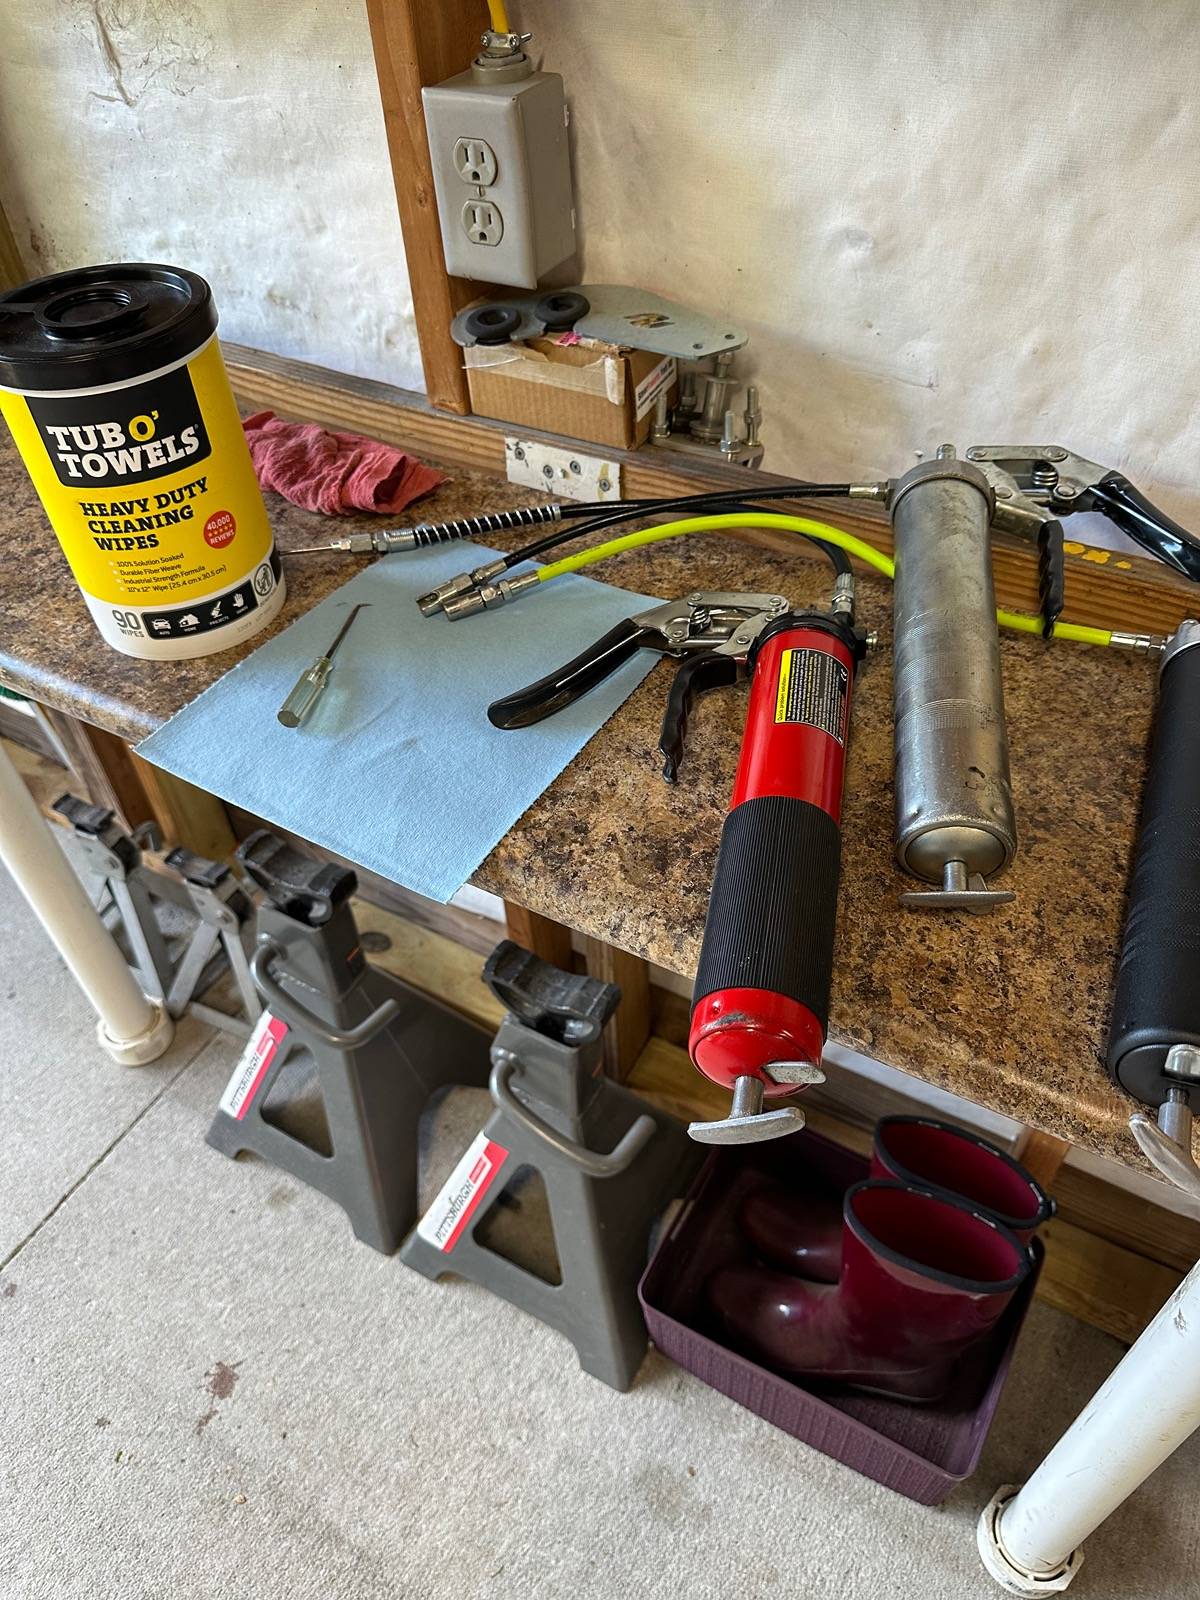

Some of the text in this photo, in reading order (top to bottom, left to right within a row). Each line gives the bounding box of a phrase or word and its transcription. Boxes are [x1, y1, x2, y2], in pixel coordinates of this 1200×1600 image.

[45, 410, 159, 451] TUB O'
[57, 426, 200, 478] TOWELS
[79, 477, 208, 517] HEAVY DUTY
[88, 504, 194, 534] CLEANING
[207, 514, 231, 531] 40,000
[93, 534, 160, 551] WIPES
[210, 529, 235, 545] REVIEWS
[133, 559, 160, 567] Solution
[160, 552, 184, 564] Soaked
[160, 563, 182, 573] Weave
[122, 565, 206, 585] Industrial Strength Formula
[188, 577, 199, 585] cm
[202, 570, 217, 580] 30.5
[112, 609, 142, 630] 90
[120, 628, 145, 638] WIPES
[229, 1055, 261, 1111] PITTSBURGH
[435, 1182, 475, 1243] PITTSBURGH
